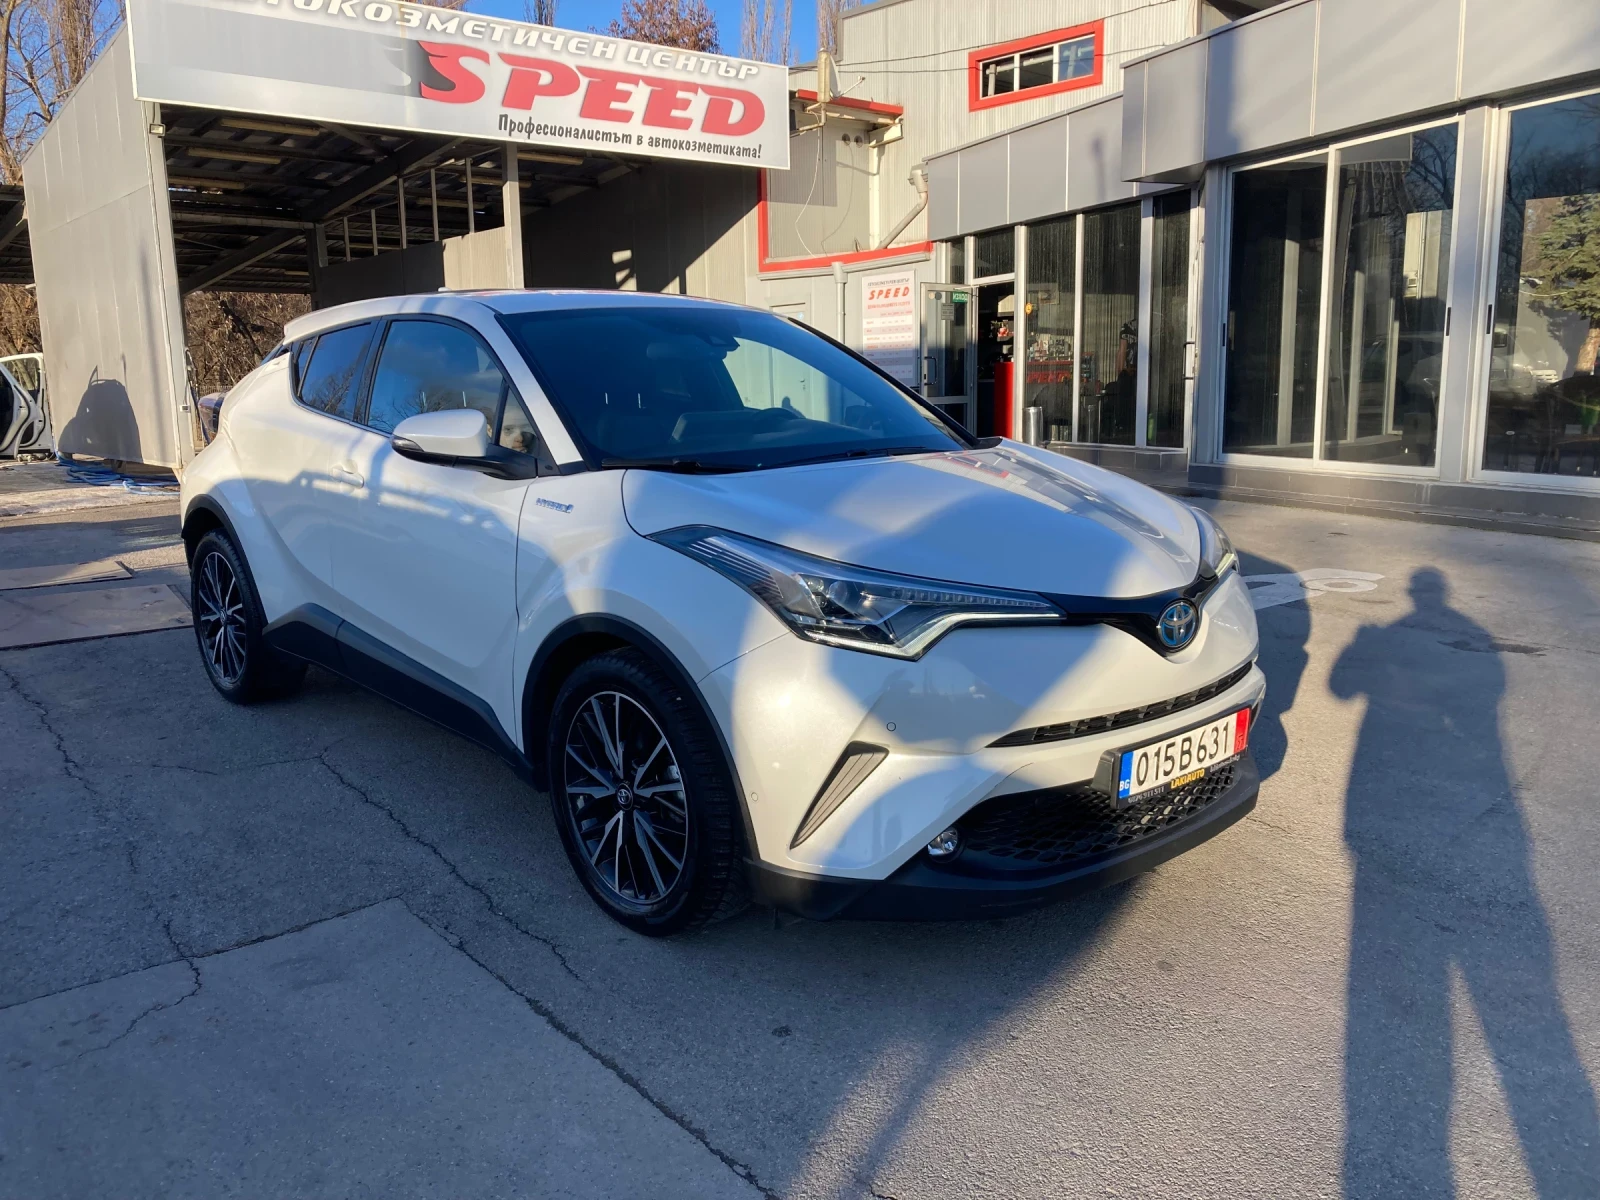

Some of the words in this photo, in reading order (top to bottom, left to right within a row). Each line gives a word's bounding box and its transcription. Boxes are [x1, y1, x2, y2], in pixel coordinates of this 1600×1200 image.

[626, 47, 759, 80] ЦЕНТЪР
[418, 40, 766, 137] SPEED
[498, 113, 633, 146] Професионалистът
[636, 134, 644, 146] в
[647, 136, 763, 159] автокозметиката!
[868, 286, 910, 301] SPEED
[1136, 721, 1229, 787] 015B631
[1119, 779, 1130, 792] BG
[1170, 767, 1205, 790] LAKIAUTO
